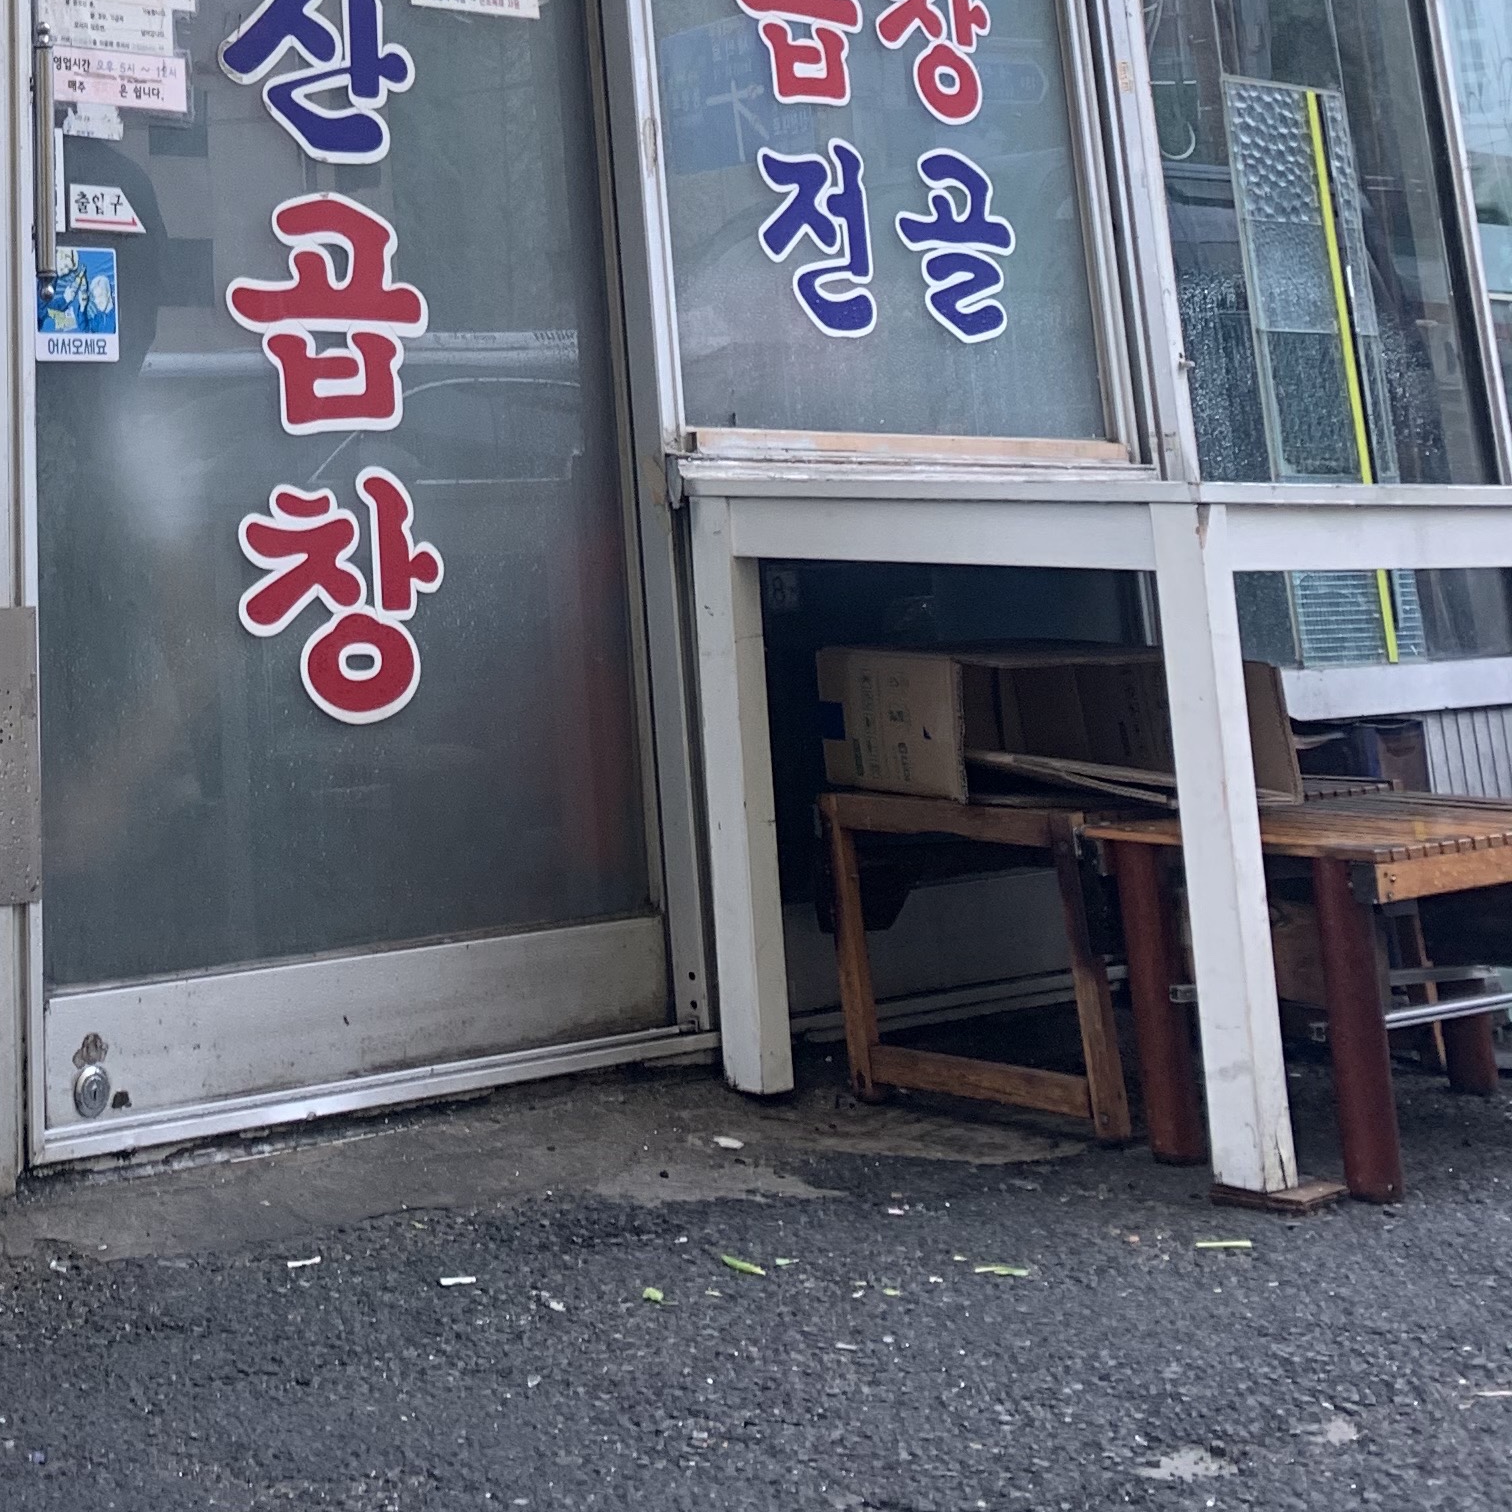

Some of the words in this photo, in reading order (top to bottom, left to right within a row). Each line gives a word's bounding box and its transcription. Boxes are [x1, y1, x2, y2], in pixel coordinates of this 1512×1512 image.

[53, 55, 90, 73] 영업시간
[96, 59, 114, 73] 오후
[119, 60, 136, 74] 5시
[67, 80, 87, 93] 매주
[118, 84, 129, 99] 은
[134, 85, 165, 102] 쉽니다.
[74, 190, 124, 216] 출입구
[757, 138, 1016, 344] 전골
[47, 337, 108, 356] 어서오세요
